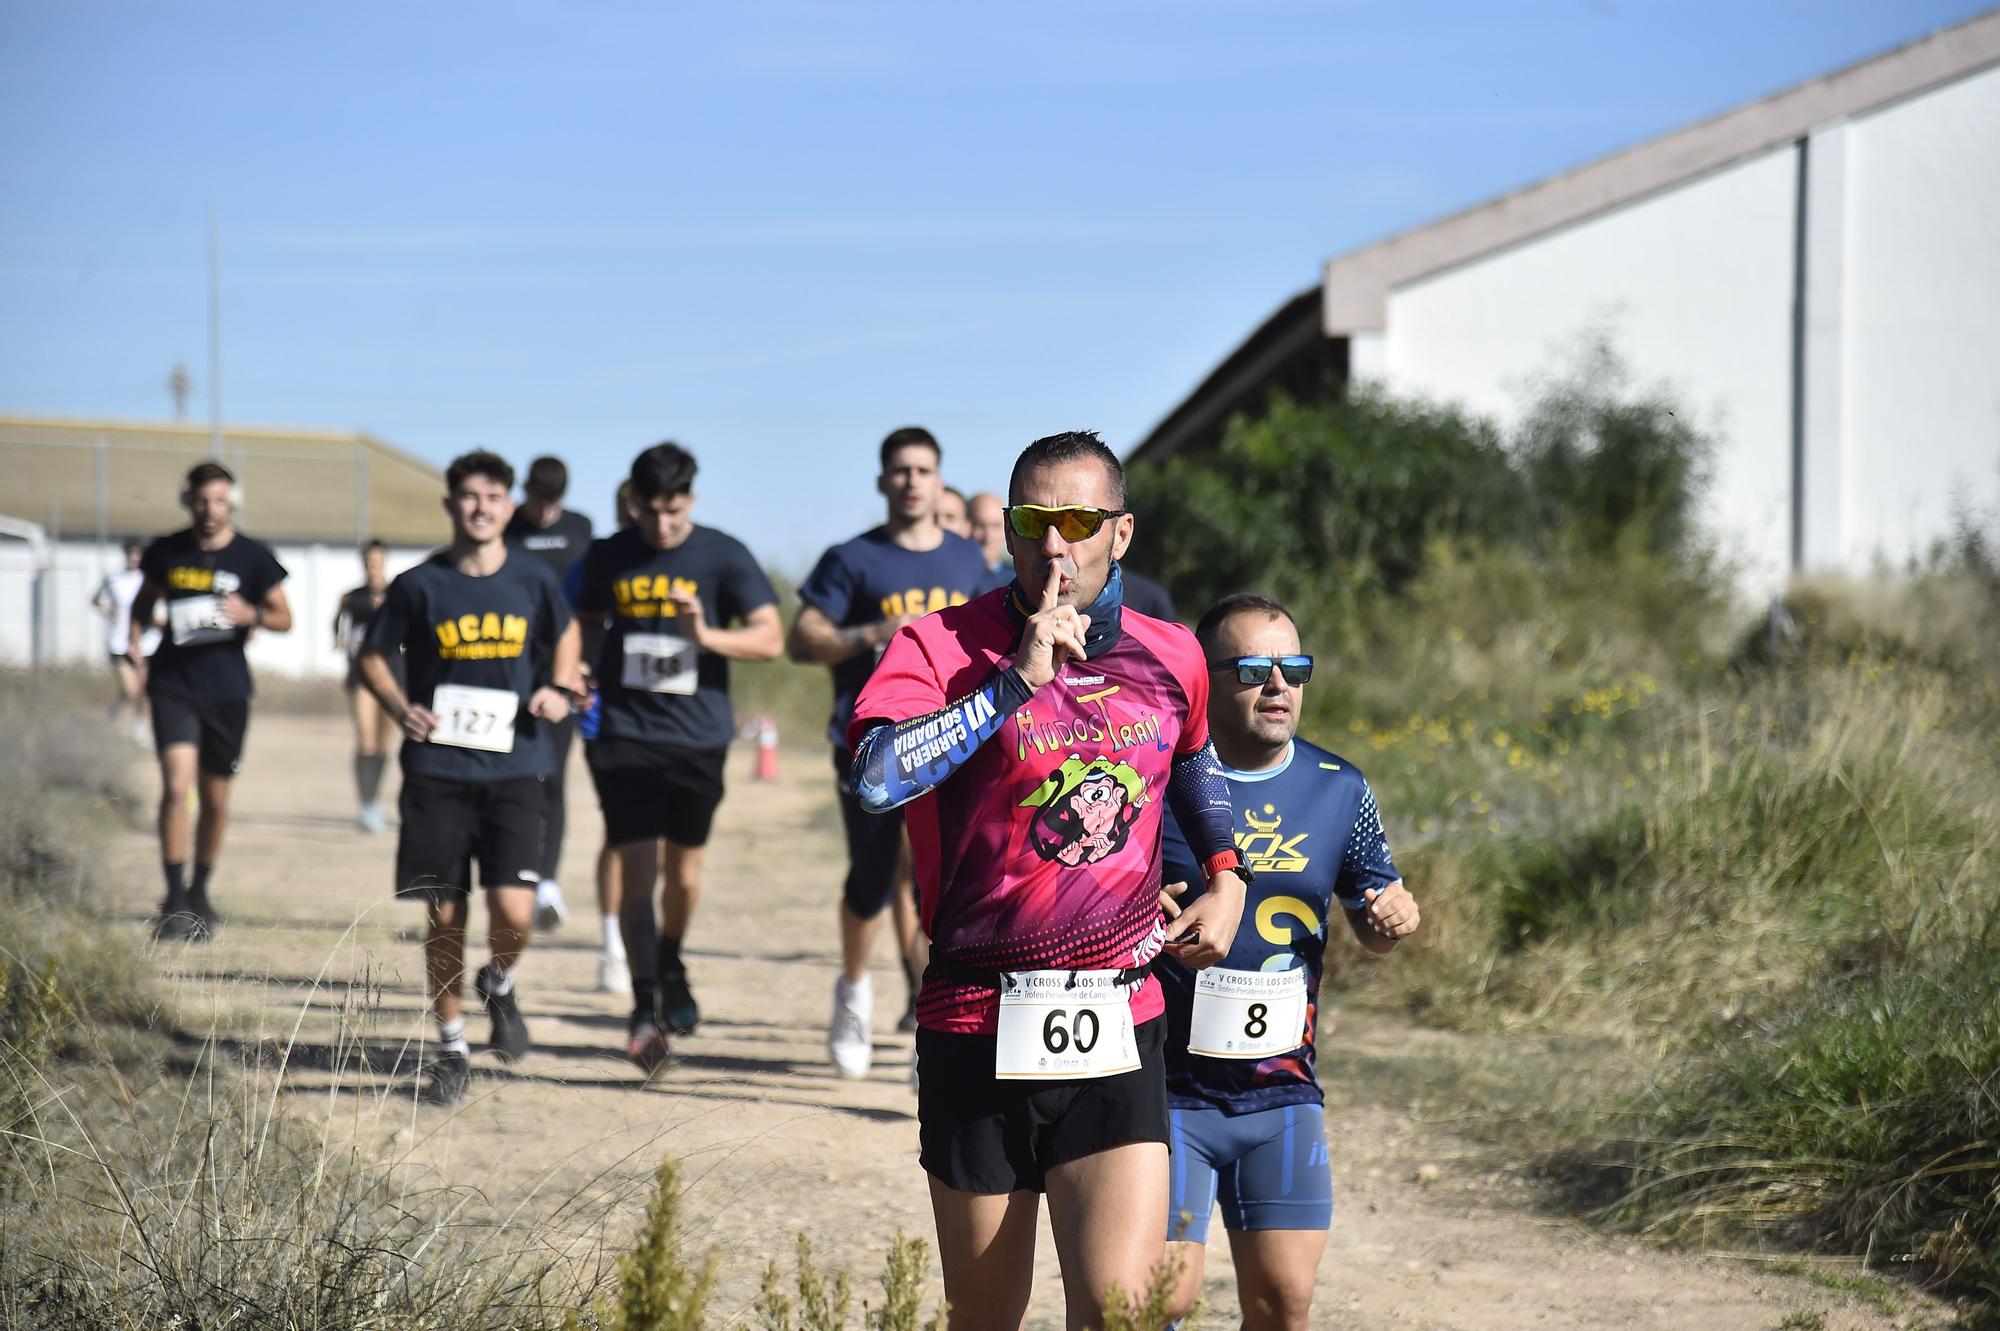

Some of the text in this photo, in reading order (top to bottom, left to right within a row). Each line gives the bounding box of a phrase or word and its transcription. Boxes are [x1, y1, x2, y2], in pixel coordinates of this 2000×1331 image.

[435, 612, 528, 648] UCAM
[452, 708, 497, 735] 127
[963, 691, 997, 732] VI
[893, 707, 962, 756] SOLIDARIA
[901, 724, 967, 773] CARRERA
[1026, 977, 1031, 987] V
[1034, 977, 1061, 987] CROSS
[1077, 977, 1094, 987] LOS
[1079, 990, 1088, 999] de
[1219, 974, 1225, 983] V
[1226, 975, 1253, 986] CROSS
[1267, 977, 1281, 986] LOS
[1042, 1008, 1100, 1054] 60
[1244, 1003, 1268, 1038] 8
